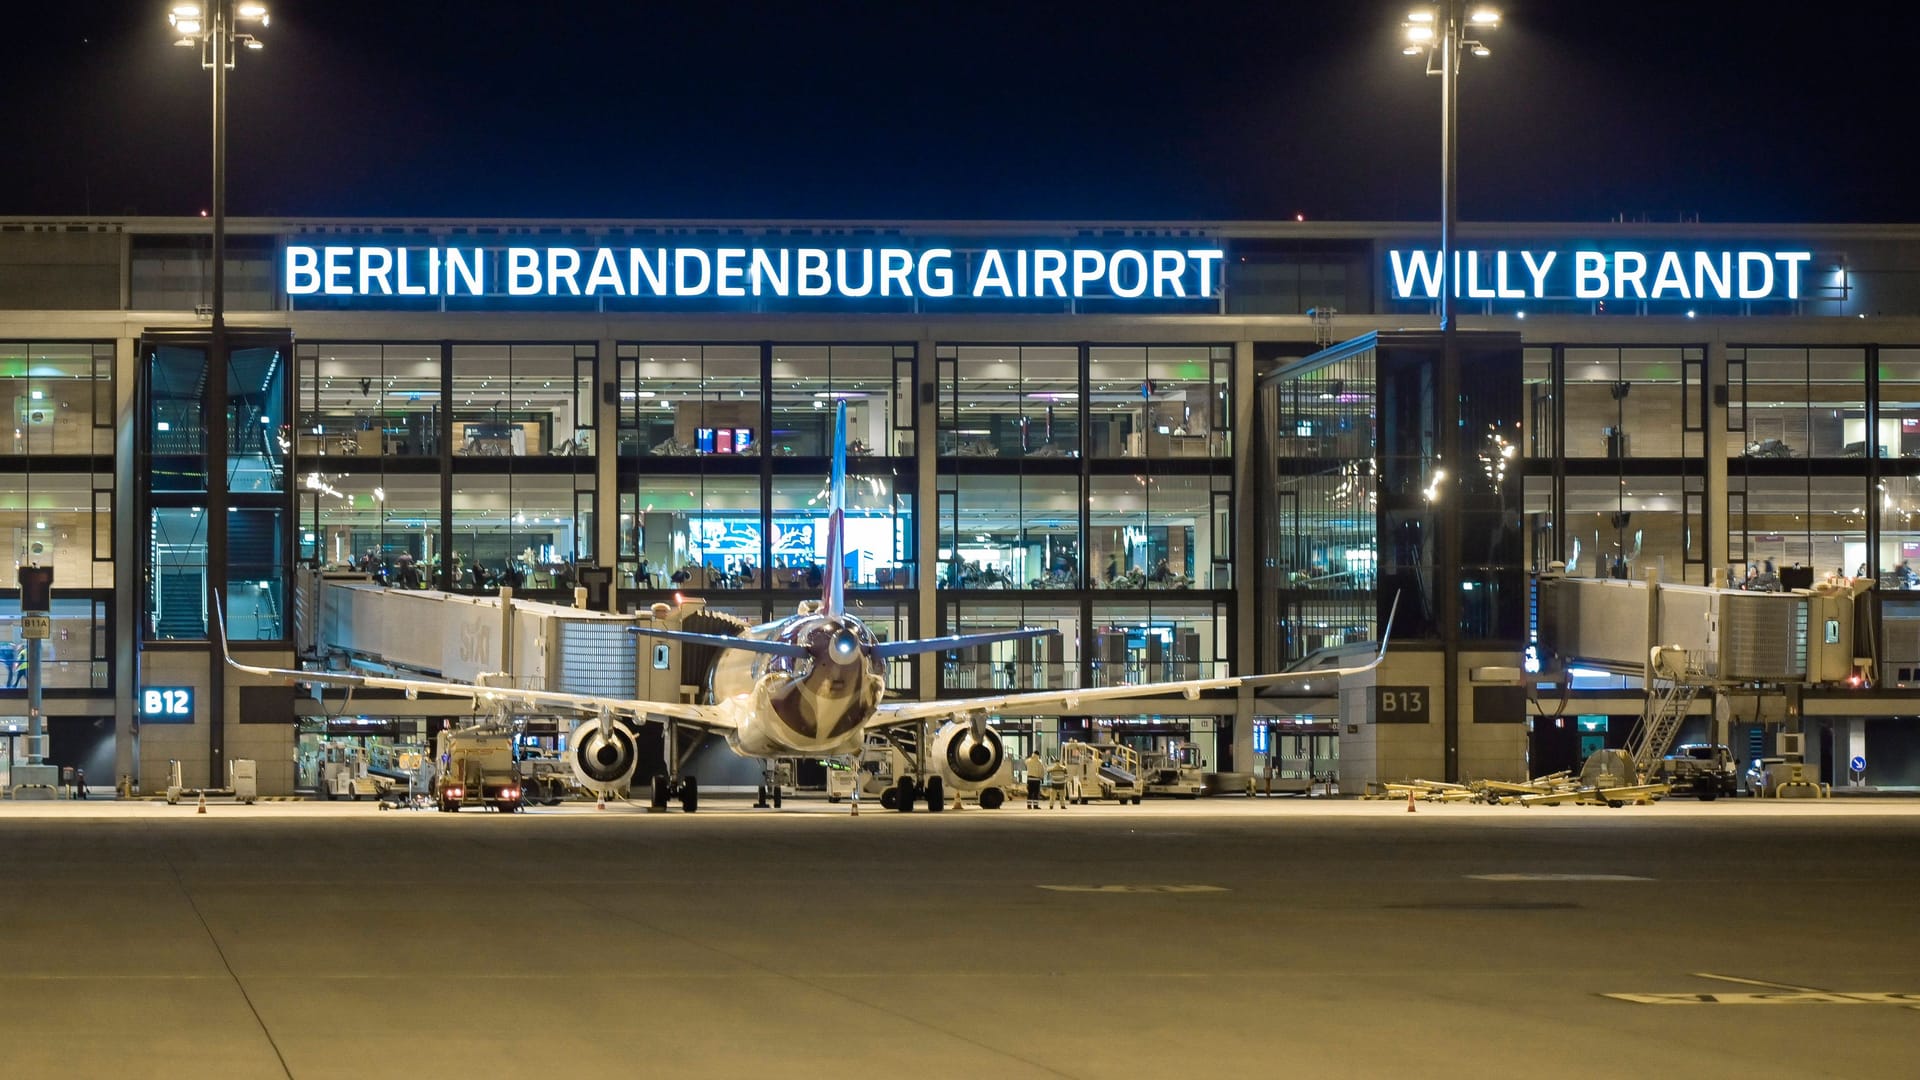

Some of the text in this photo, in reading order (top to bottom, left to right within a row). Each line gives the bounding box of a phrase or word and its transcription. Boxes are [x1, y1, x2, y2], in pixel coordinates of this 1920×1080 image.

[286, 246, 1223, 298] BERLIN BRANDENBURG AIRPORT
[1575, 251, 1811, 299] BRANDT
[24, 619, 47, 628] B11A
[145, 690, 189, 713] B12
[1382, 692, 1422, 712] B13
